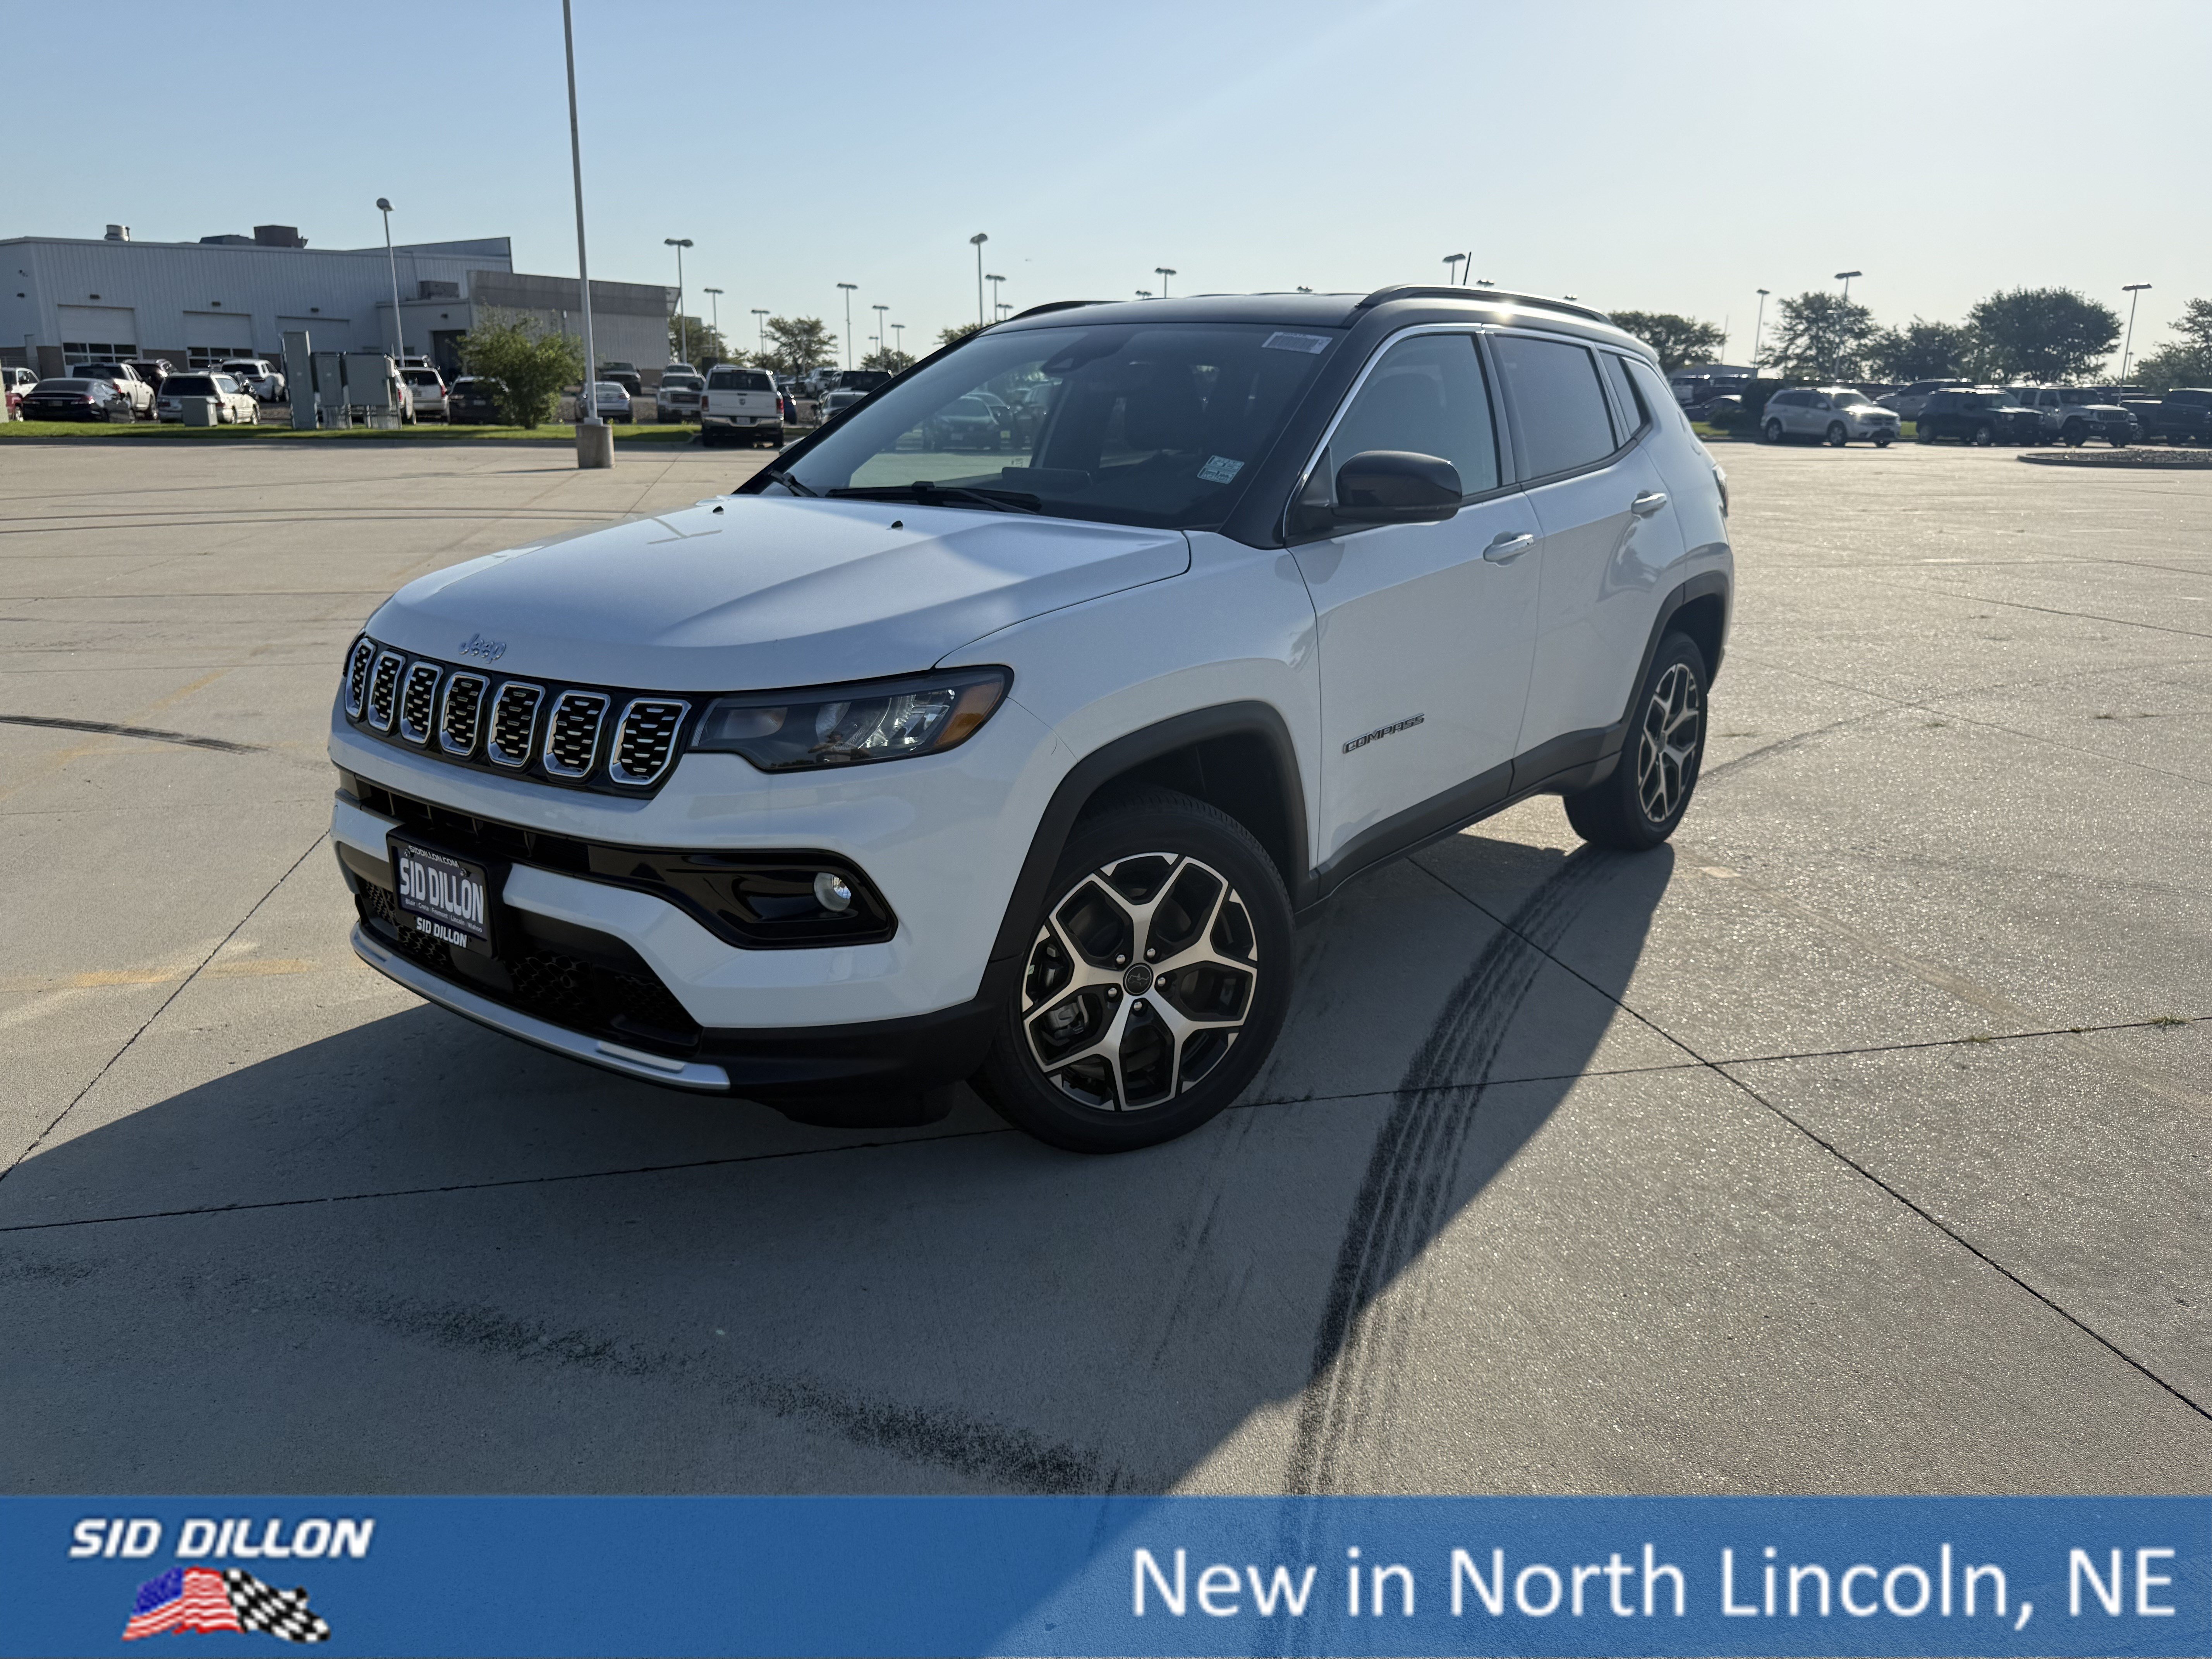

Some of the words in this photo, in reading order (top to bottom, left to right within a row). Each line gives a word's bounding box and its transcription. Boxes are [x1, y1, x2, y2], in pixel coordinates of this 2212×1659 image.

[458, 633, 506, 664] Jeep
[1342, 713, 1425, 754] COMPASS
[409, 845, 459, 868] SIDDILLON.COM
[400, 857, 426, 901] SID
[428, 867, 483, 924] DILLON
[416, 917, 432, 934] SID
[433, 924, 468, 948] DILLON
